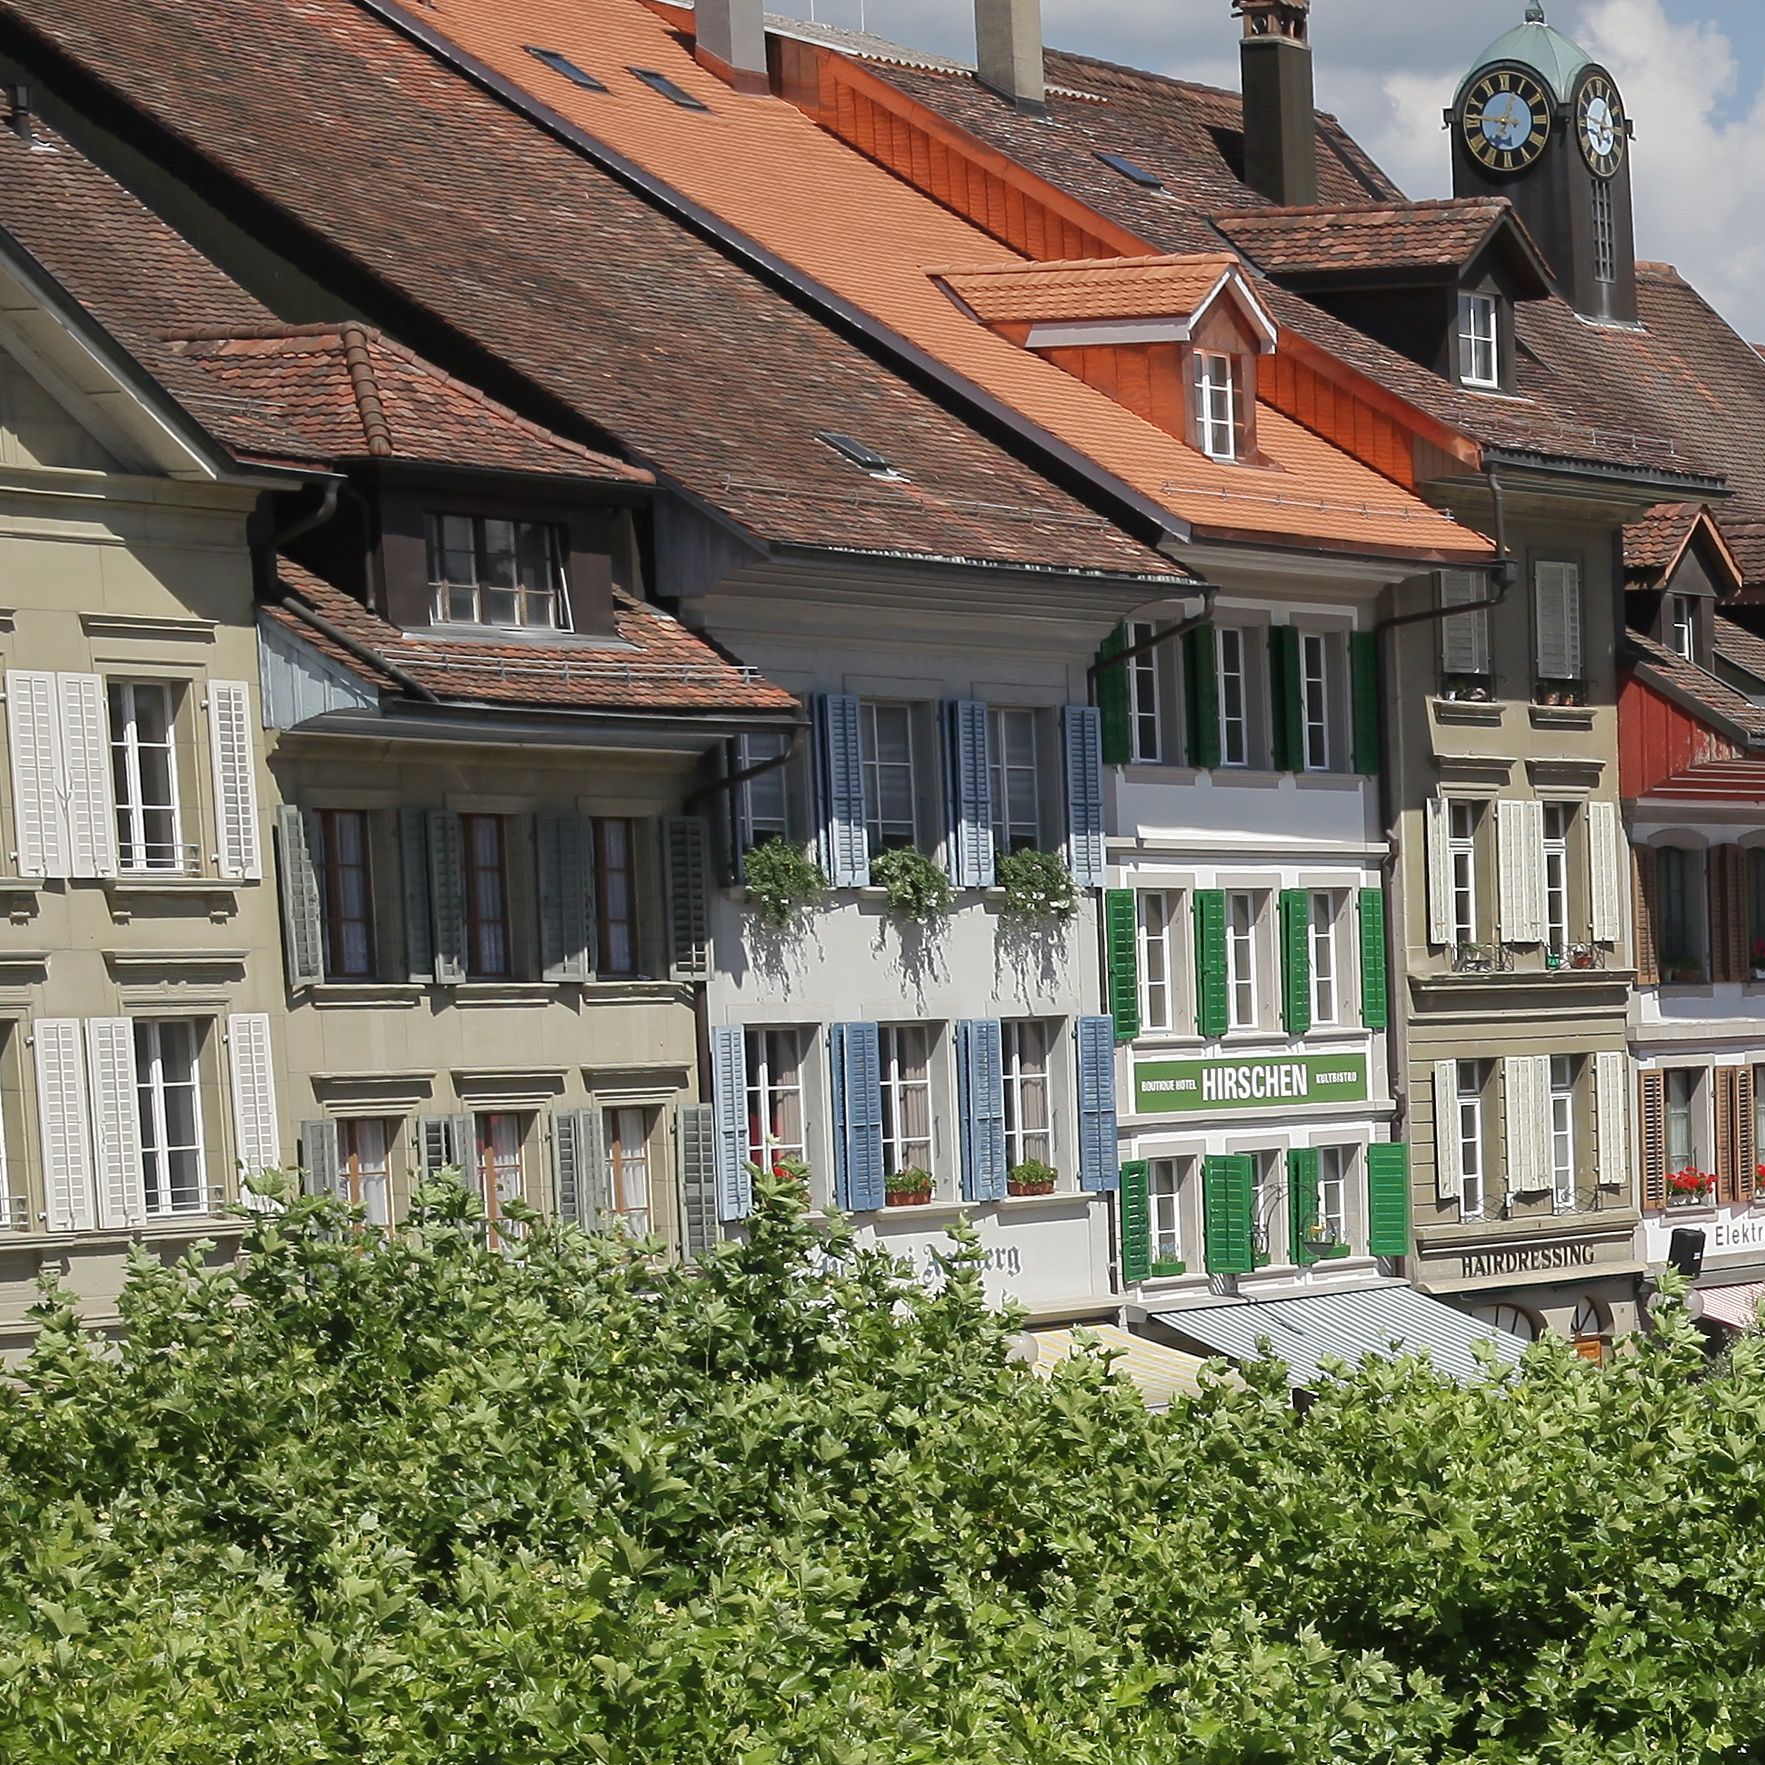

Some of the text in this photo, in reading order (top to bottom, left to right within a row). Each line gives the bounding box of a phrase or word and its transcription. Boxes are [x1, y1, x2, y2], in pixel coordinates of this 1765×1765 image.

[1141, 1079, 1197, 1091] BOUTIQUE HOTEL
[1201, 1064, 1308, 1101] HIRSCHEN
[1462, 1244, 1595, 1278] HAIRDRESSING
